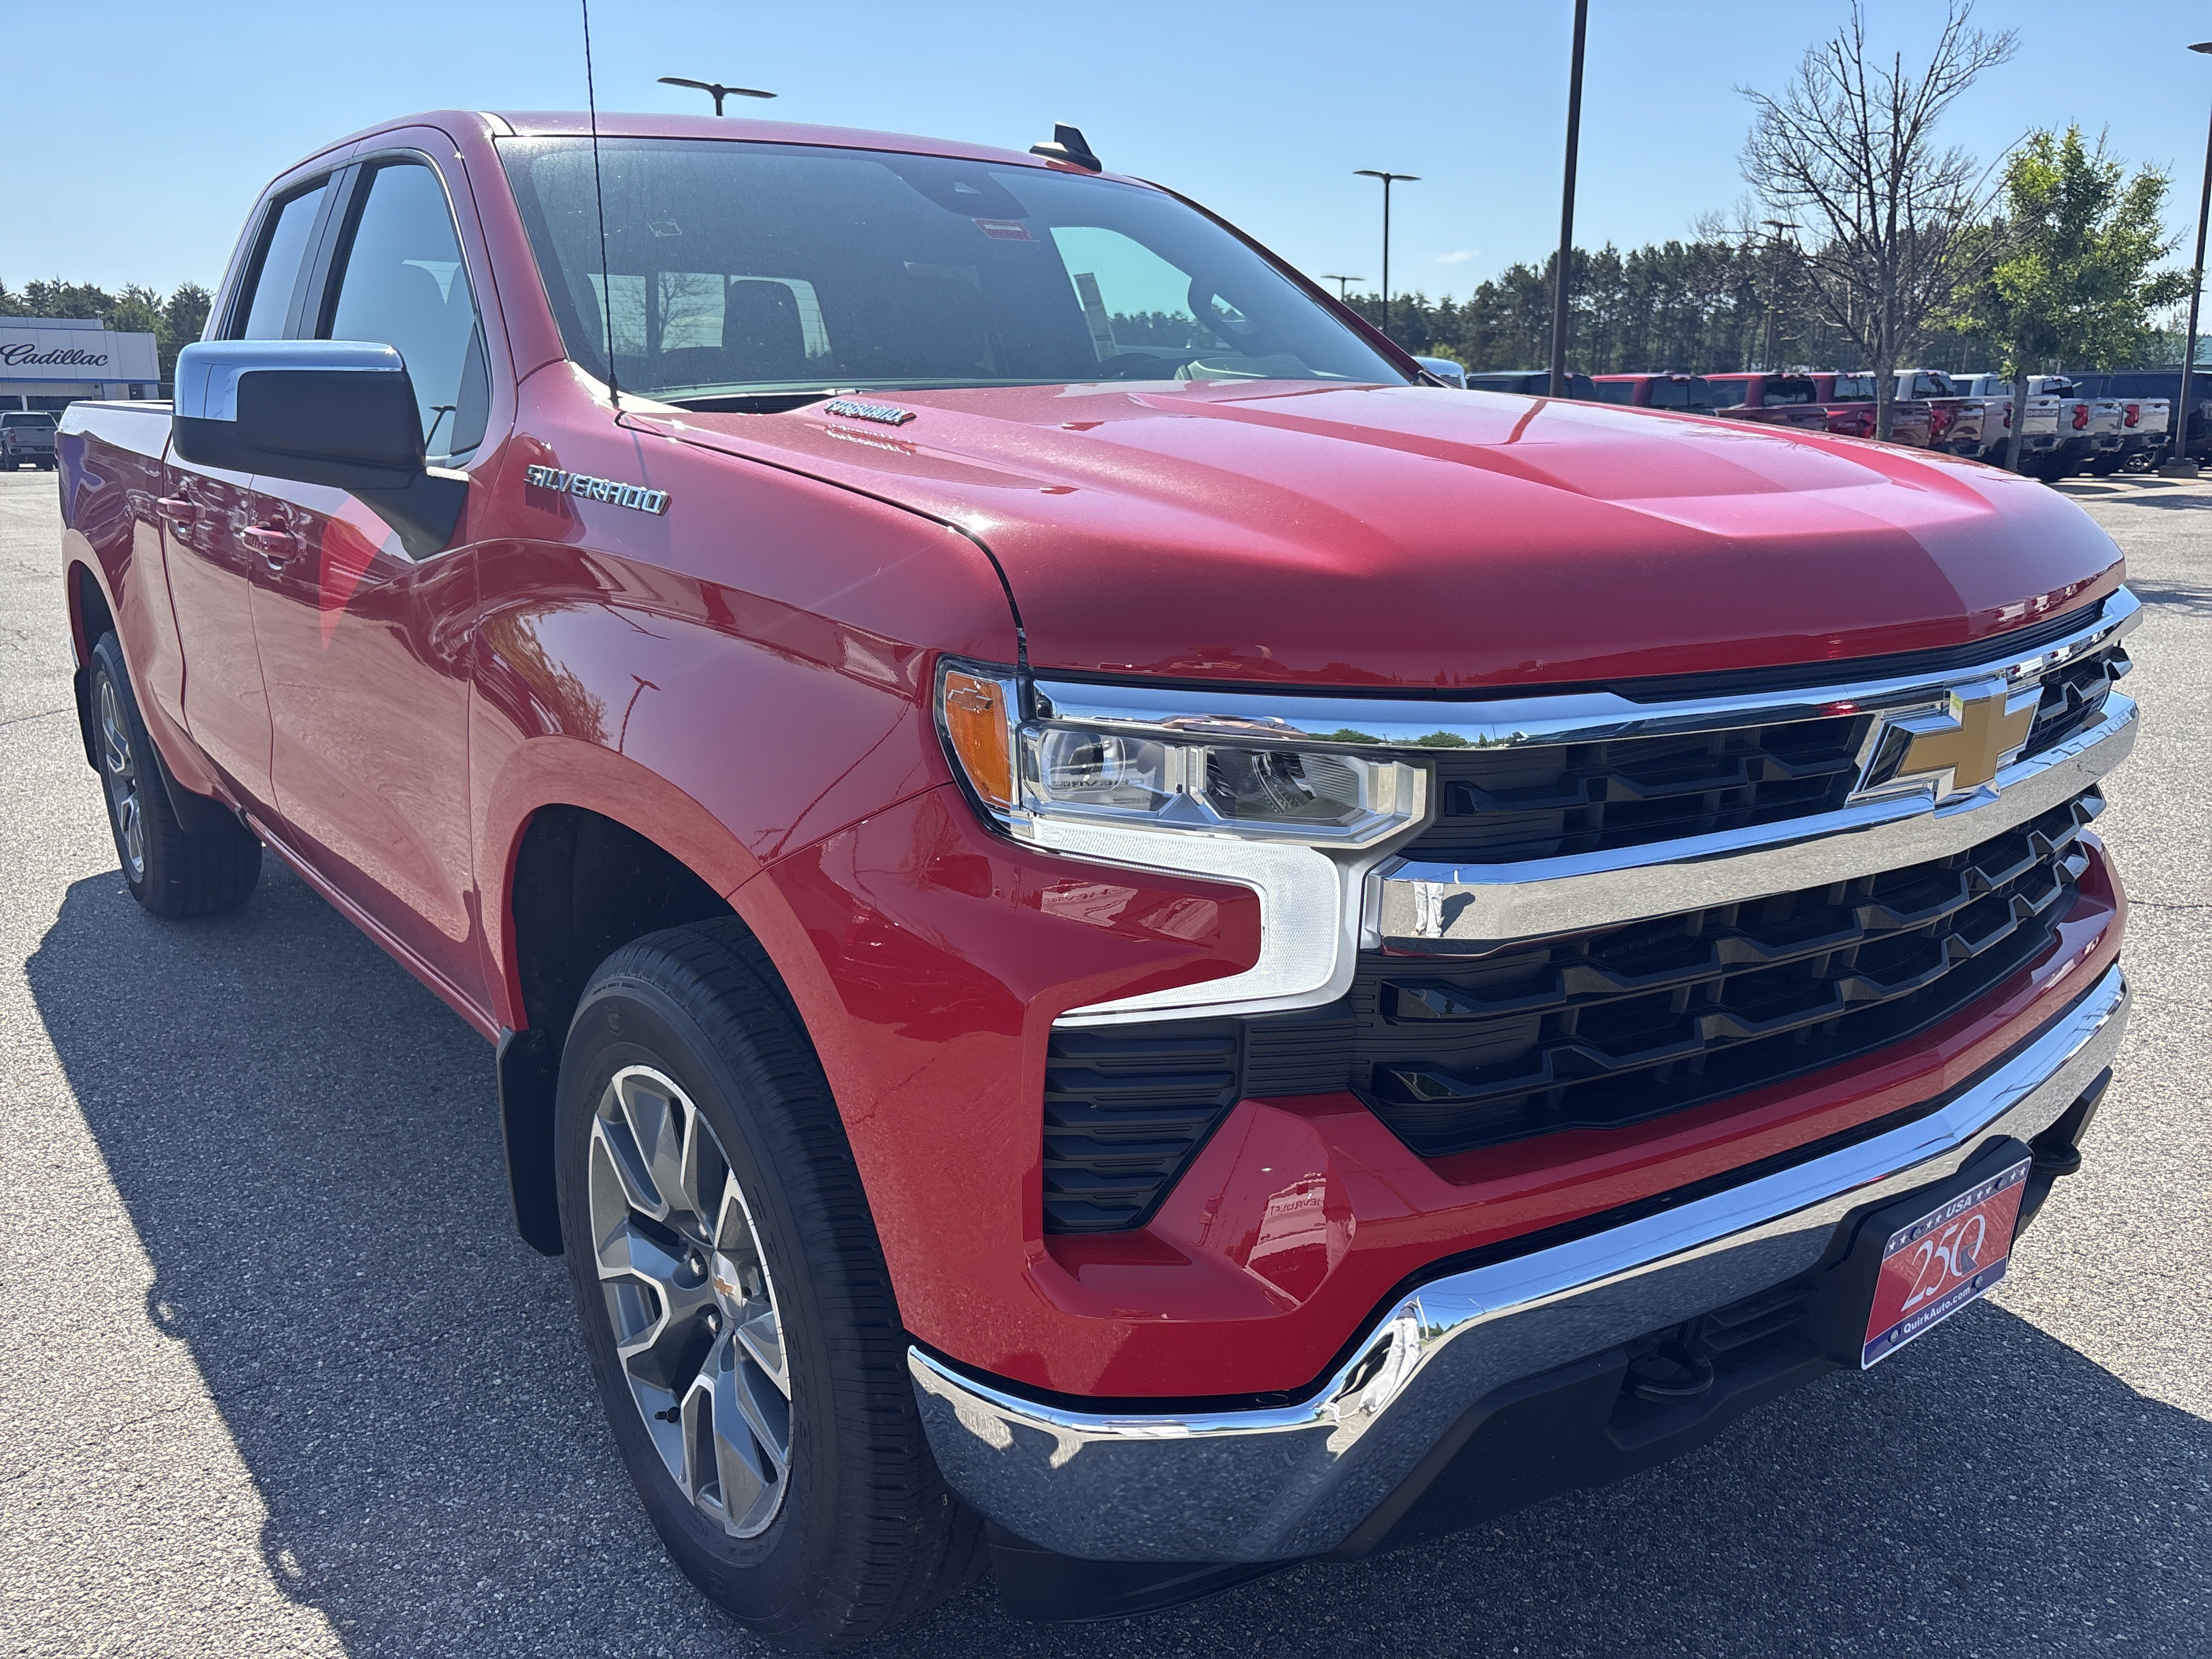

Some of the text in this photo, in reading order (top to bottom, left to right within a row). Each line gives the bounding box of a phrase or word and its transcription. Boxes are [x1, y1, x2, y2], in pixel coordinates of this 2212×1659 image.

[0, 343, 109, 366] Cadillac
[523, 464, 670, 515] SILVERADO
[1945, 1195, 1972, 1218] USA
[1900, 1214, 1985, 1312] 250
[1903, 1286, 1971, 1334] QuirkAuto.com
